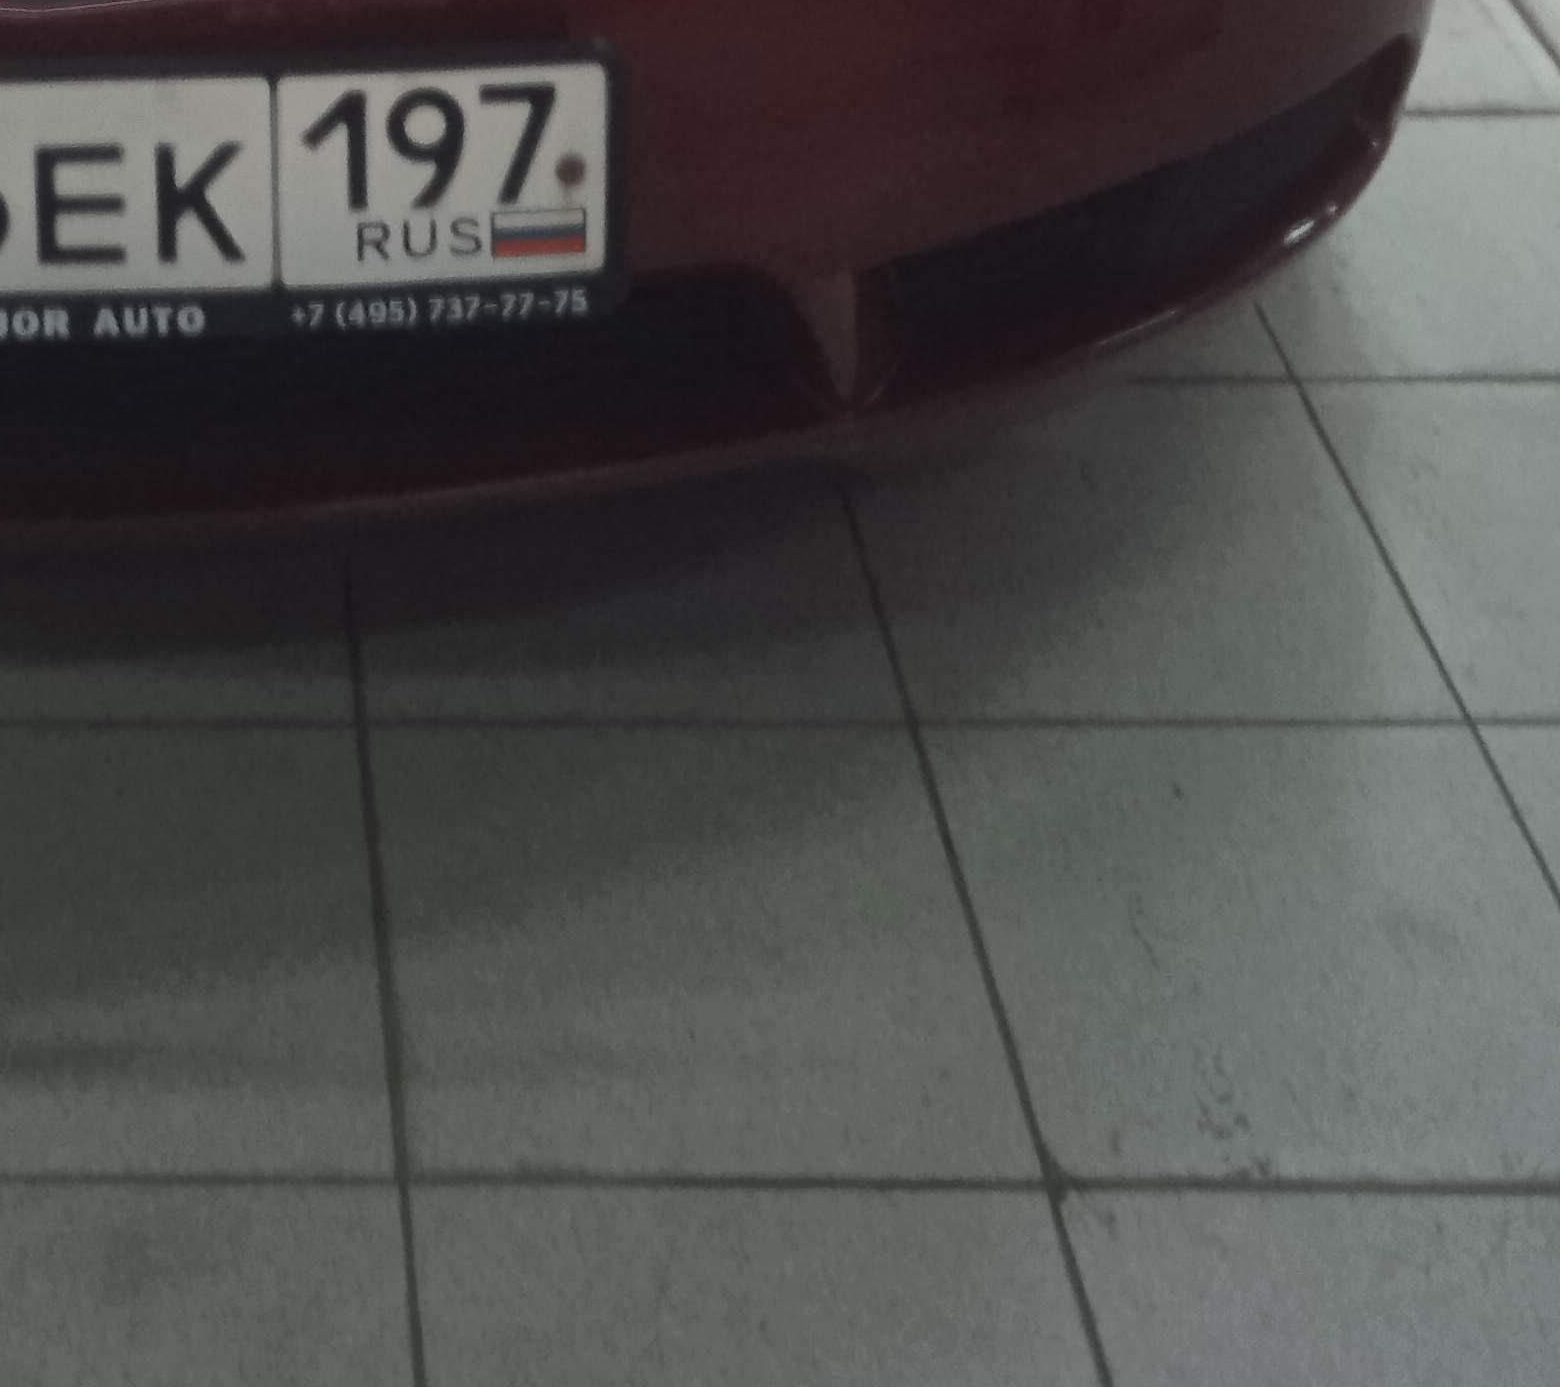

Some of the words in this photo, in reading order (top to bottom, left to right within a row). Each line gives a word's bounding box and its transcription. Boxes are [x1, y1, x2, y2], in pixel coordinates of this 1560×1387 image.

[301, 82, 555, 211] 197
[356, 217, 483, 261] RUS
[94, 305, 205, 337] AUTO
[291, 302, 324, 327] +7
[336, 296, 417, 330] (495)
[429, 288, 588, 322] 737-77-75
